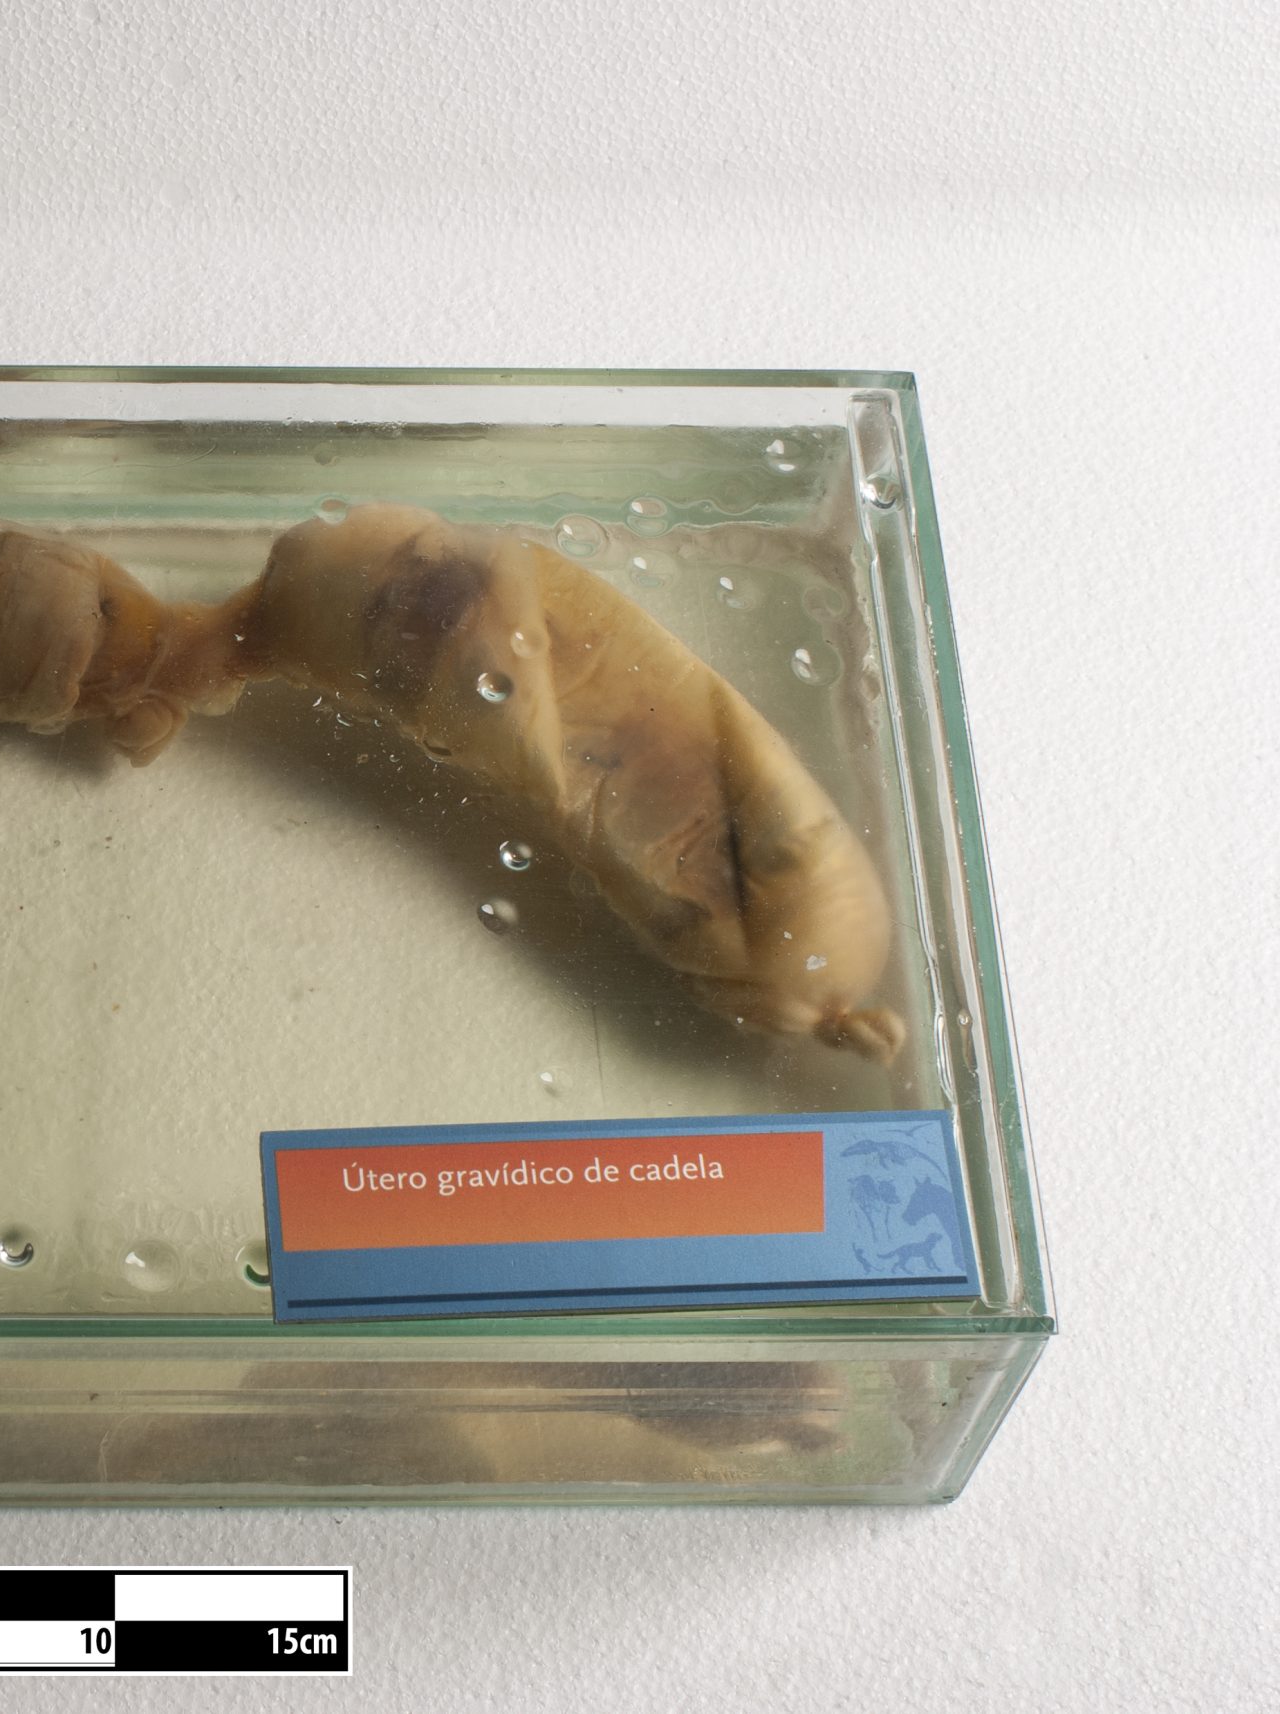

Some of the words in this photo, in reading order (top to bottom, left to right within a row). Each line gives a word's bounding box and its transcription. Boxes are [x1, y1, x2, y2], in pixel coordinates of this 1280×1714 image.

[343, 1161, 427, 1192] Útero
[438, 1158, 574, 1196] gravídico
[584, 1156, 619, 1184] de
[629, 1153, 724, 1182] cadela
